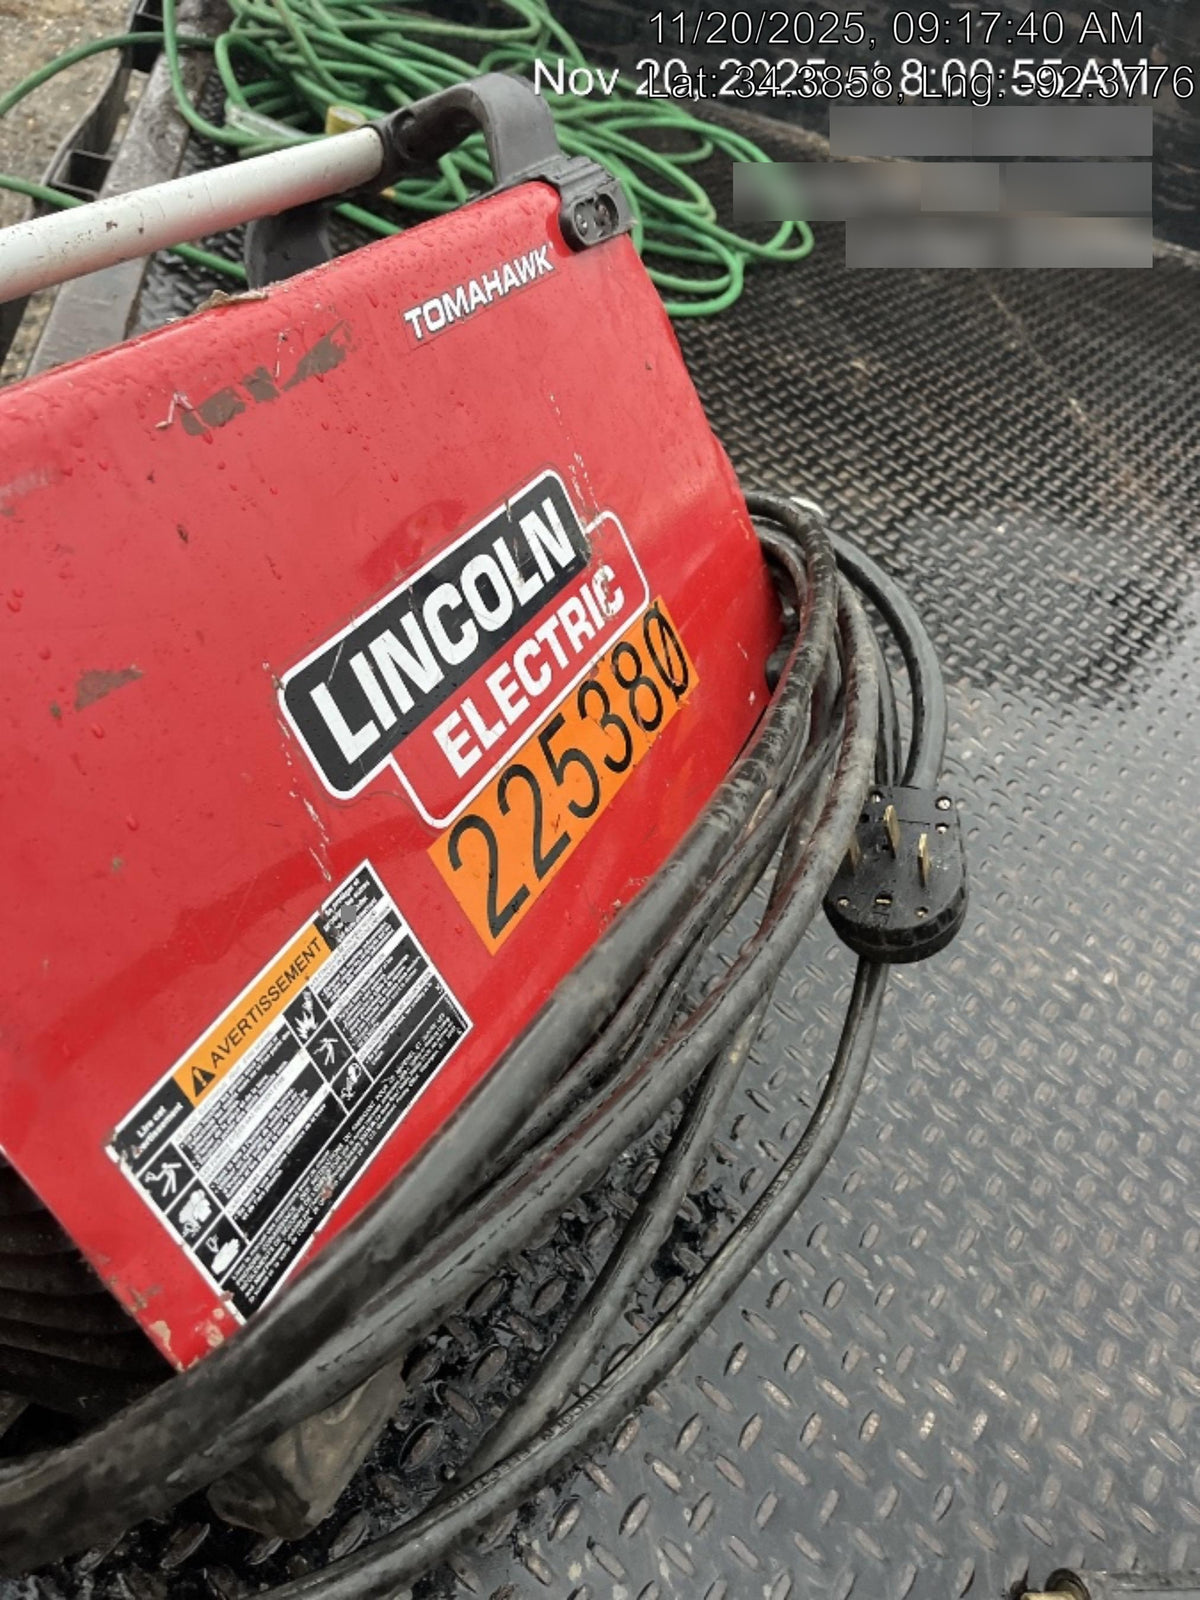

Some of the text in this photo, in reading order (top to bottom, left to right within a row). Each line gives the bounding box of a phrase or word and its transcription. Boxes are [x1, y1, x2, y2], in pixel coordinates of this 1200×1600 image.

[402, 244, 555, 340] TOMAHAWK
[309, 496, 577, 766] LINCOLN
[431, 563, 625, 780] ELECTRIC
[446, 601, 690, 940] 225380
[208, 937, 325, 1069] AVERTISSEMENT
